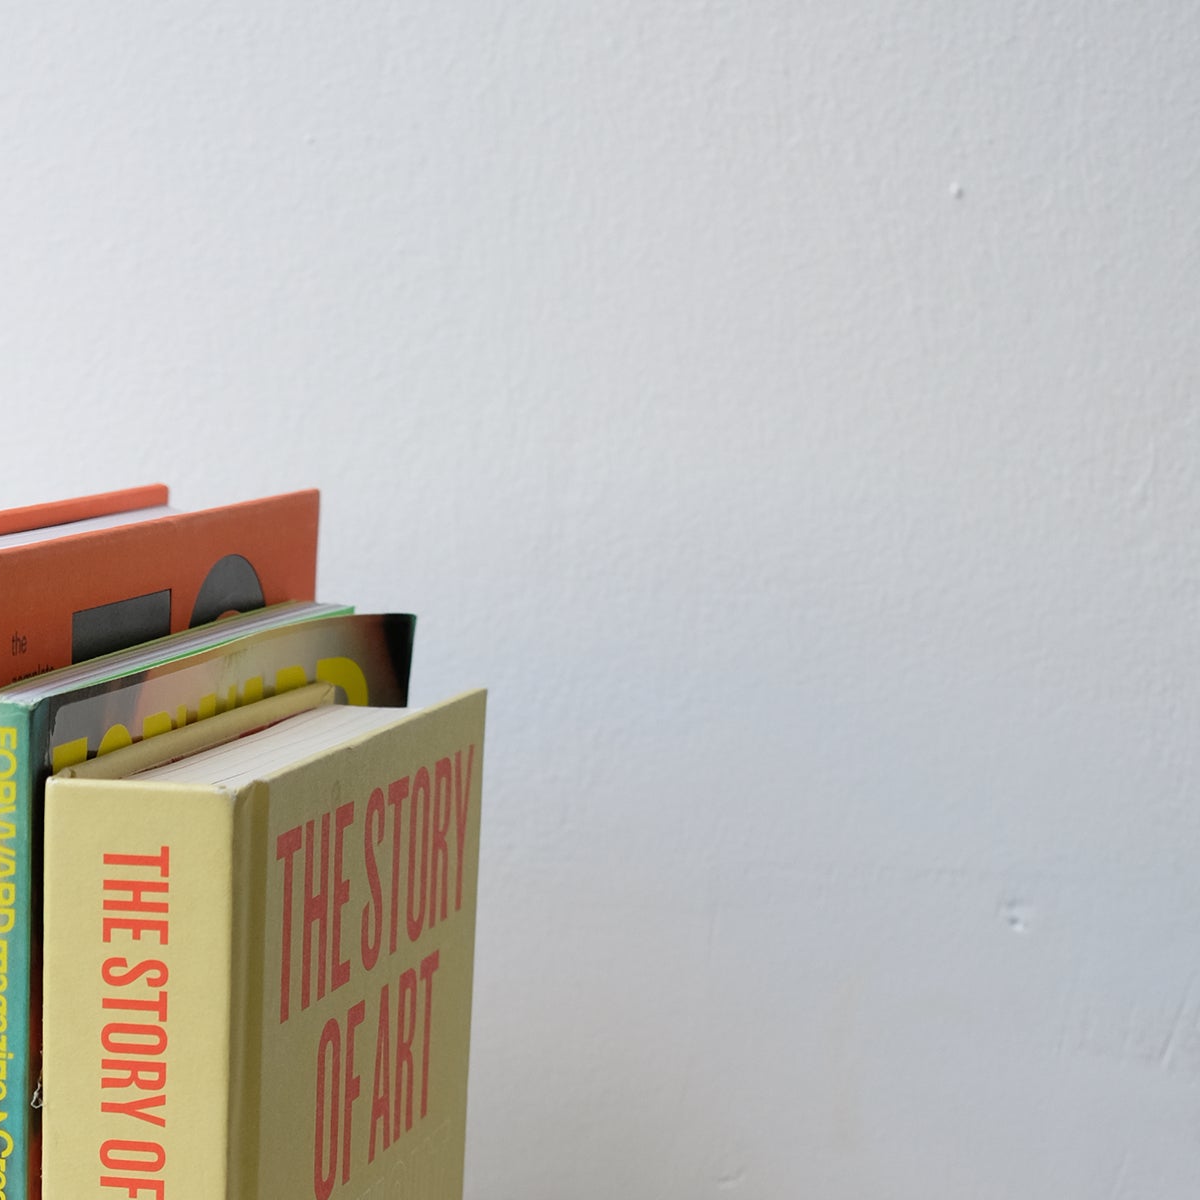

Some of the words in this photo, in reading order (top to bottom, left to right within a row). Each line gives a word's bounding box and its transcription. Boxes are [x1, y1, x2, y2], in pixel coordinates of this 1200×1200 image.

[12, 631, 27, 656] the
[102, 846, 169, 945] THE
[277, 800, 355, 1024] THE
[360, 744, 476, 971] STORY
[100, 957, 169, 1128] STORY
[367, 949, 440, 1165] ART
